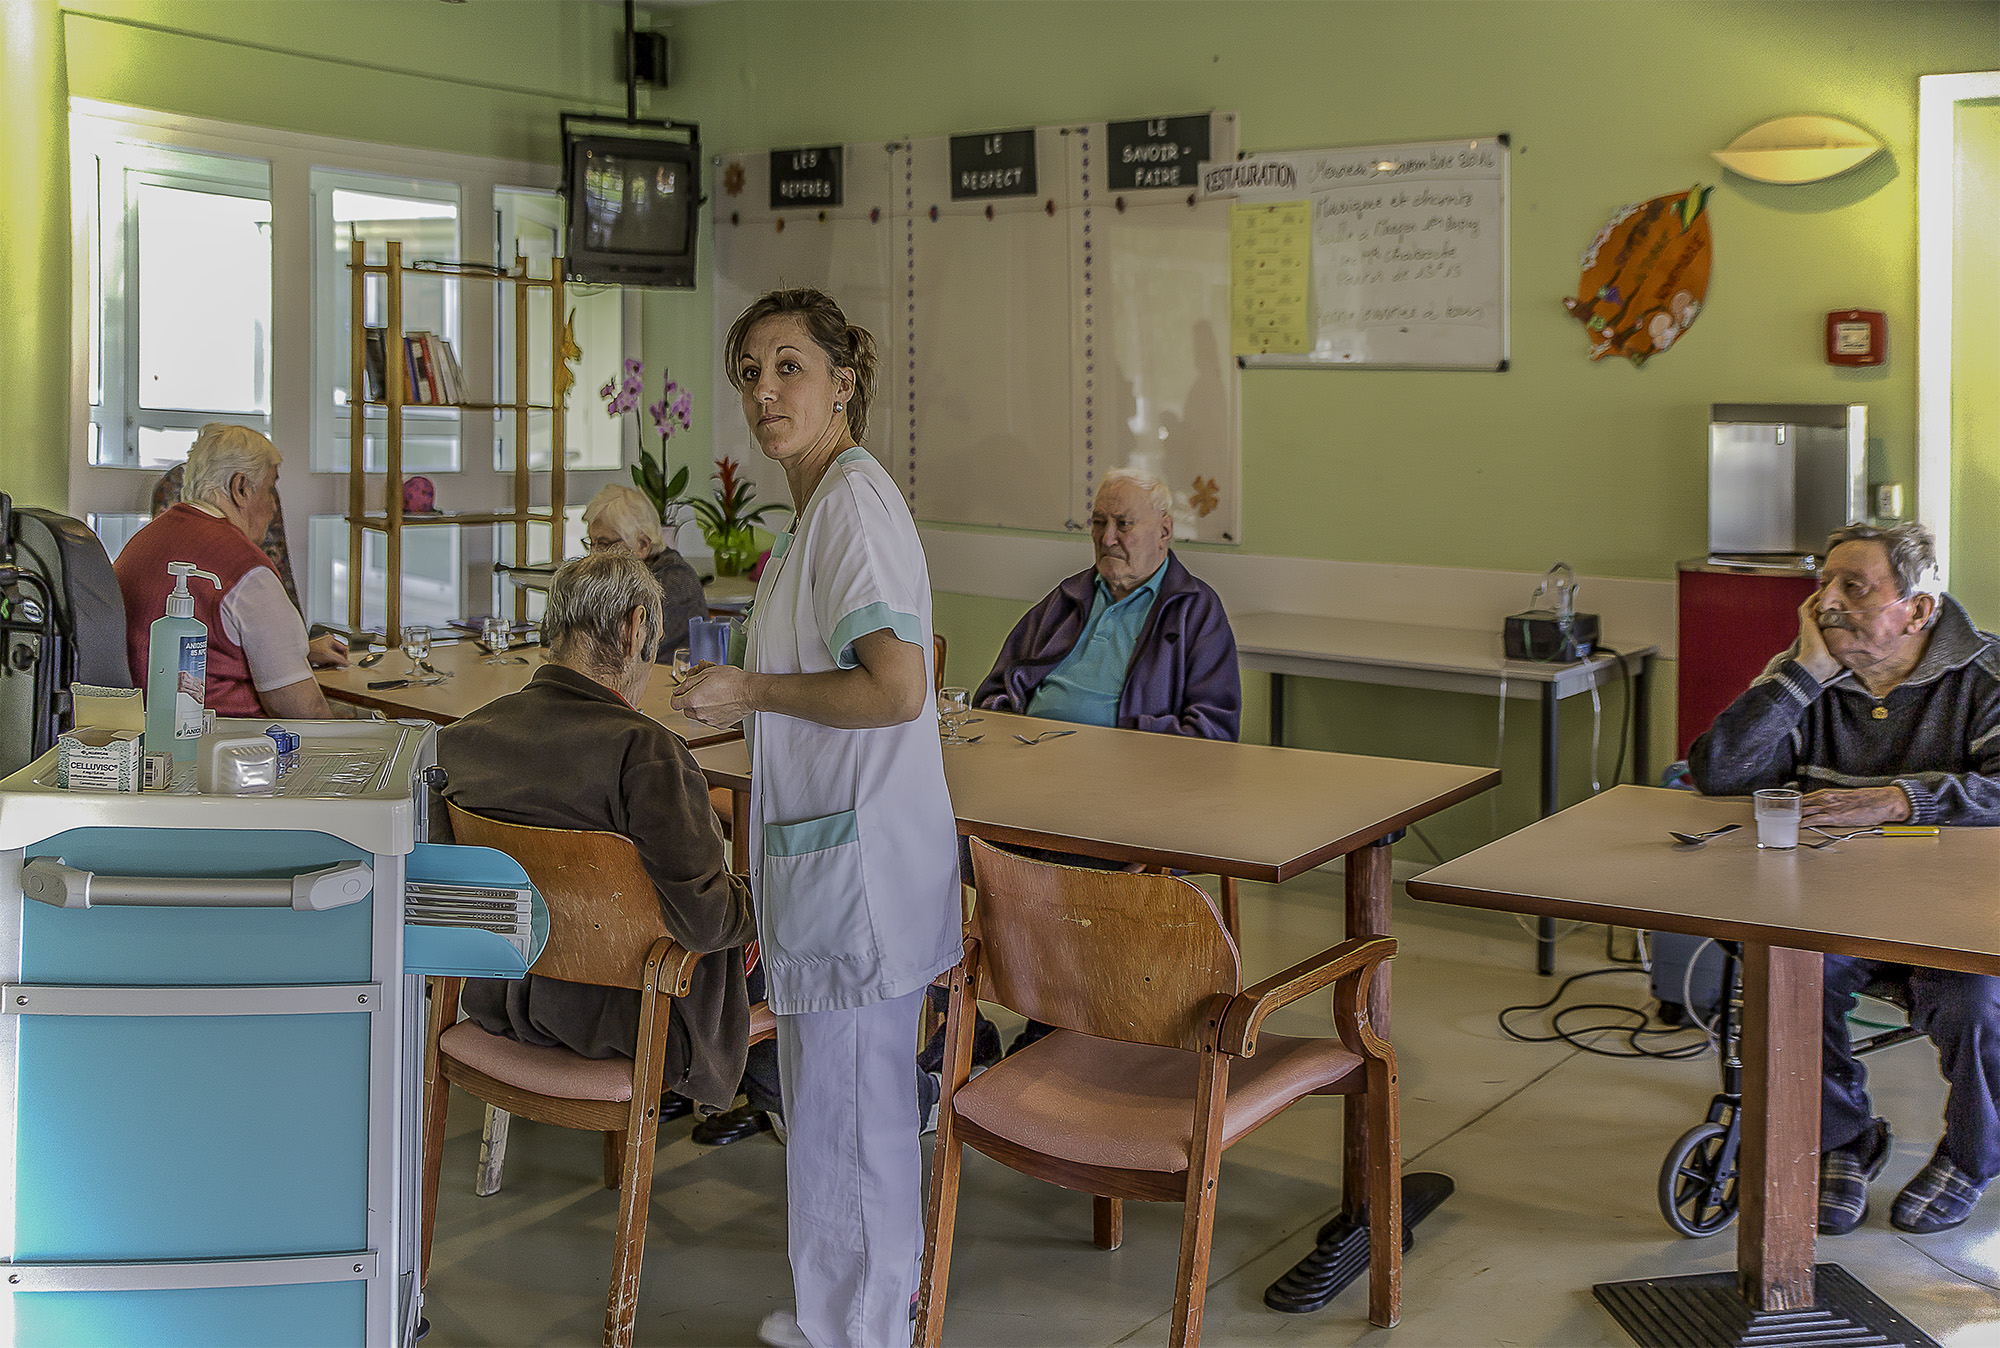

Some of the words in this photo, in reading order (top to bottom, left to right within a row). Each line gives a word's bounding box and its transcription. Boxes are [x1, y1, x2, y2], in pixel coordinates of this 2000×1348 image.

[1147, 119, 1167, 137] LE
[984, 134, 1003, 155] LE
[1122, 142, 1179, 163] SAVOIR
[793, 150, 817, 170] LES
[961, 168, 1023, 190] RESPECT
[1135, 166, 1181, 188] FAIRE
[1204, 163, 1298, 193] RESTAURATION
